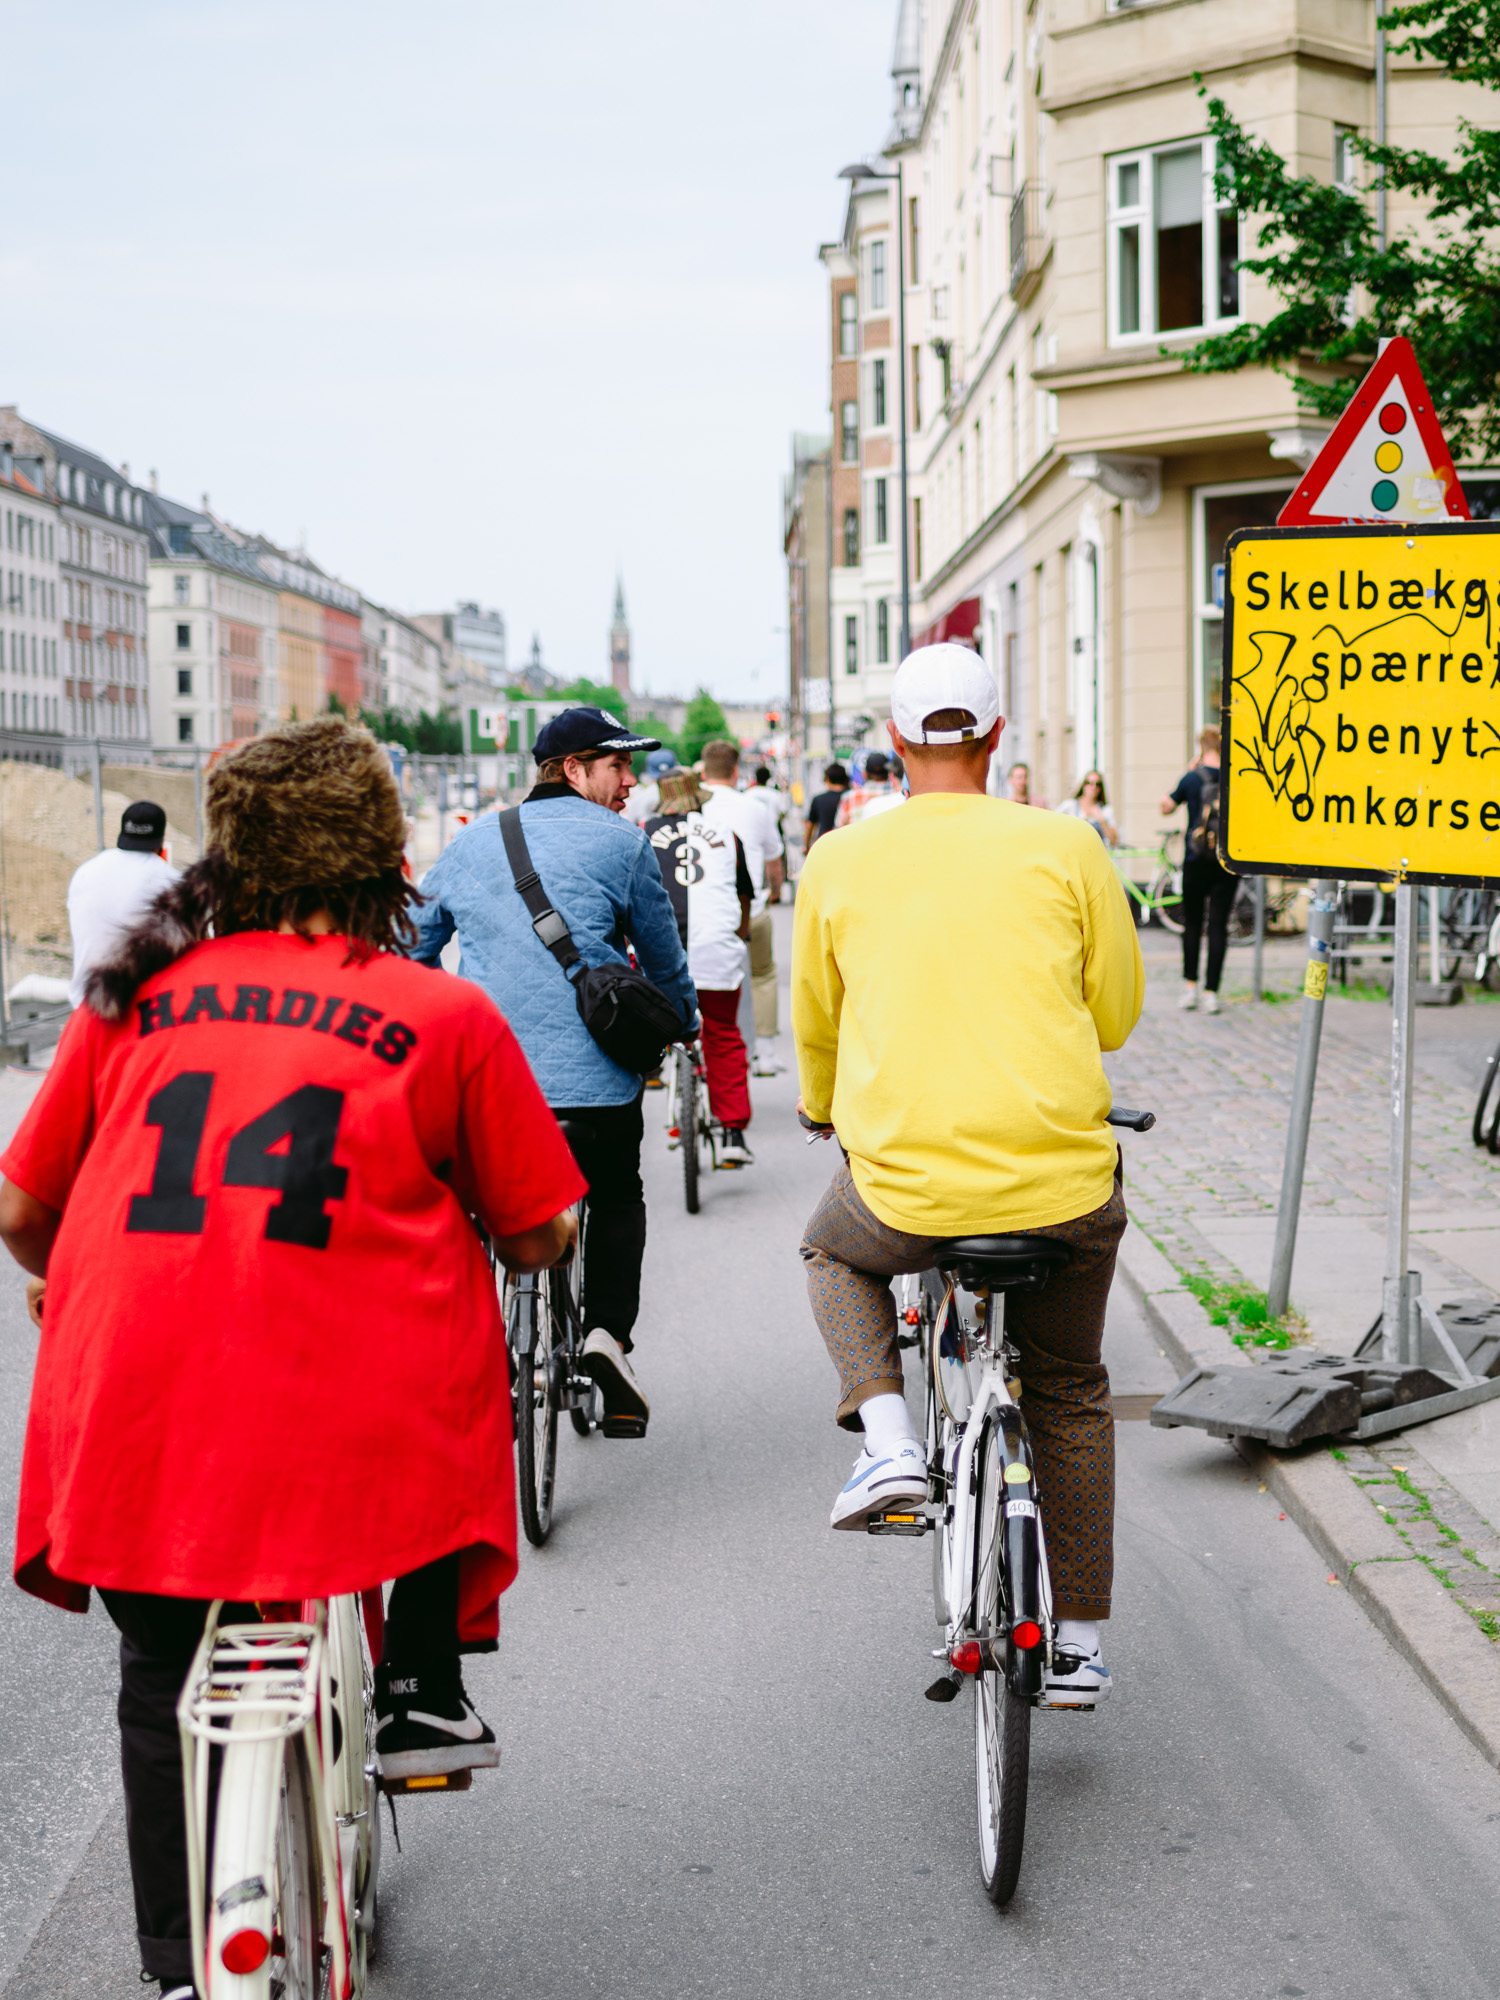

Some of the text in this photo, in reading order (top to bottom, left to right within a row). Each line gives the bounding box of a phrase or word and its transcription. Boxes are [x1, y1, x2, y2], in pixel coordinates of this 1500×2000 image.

[1246, 569, 1500, 618] Skelbækg
[1337, 713, 1478, 765] benyt
[1292, 786, 1500, 832] omkørse
[674, 842, 705, 886] 3
[138, 984, 418, 1066] HARDIES
[126, 1071, 349, 1251] 14
[1009, 1501, 1033, 1514] 401
[389, 1677, 419, 1695] NIKE
